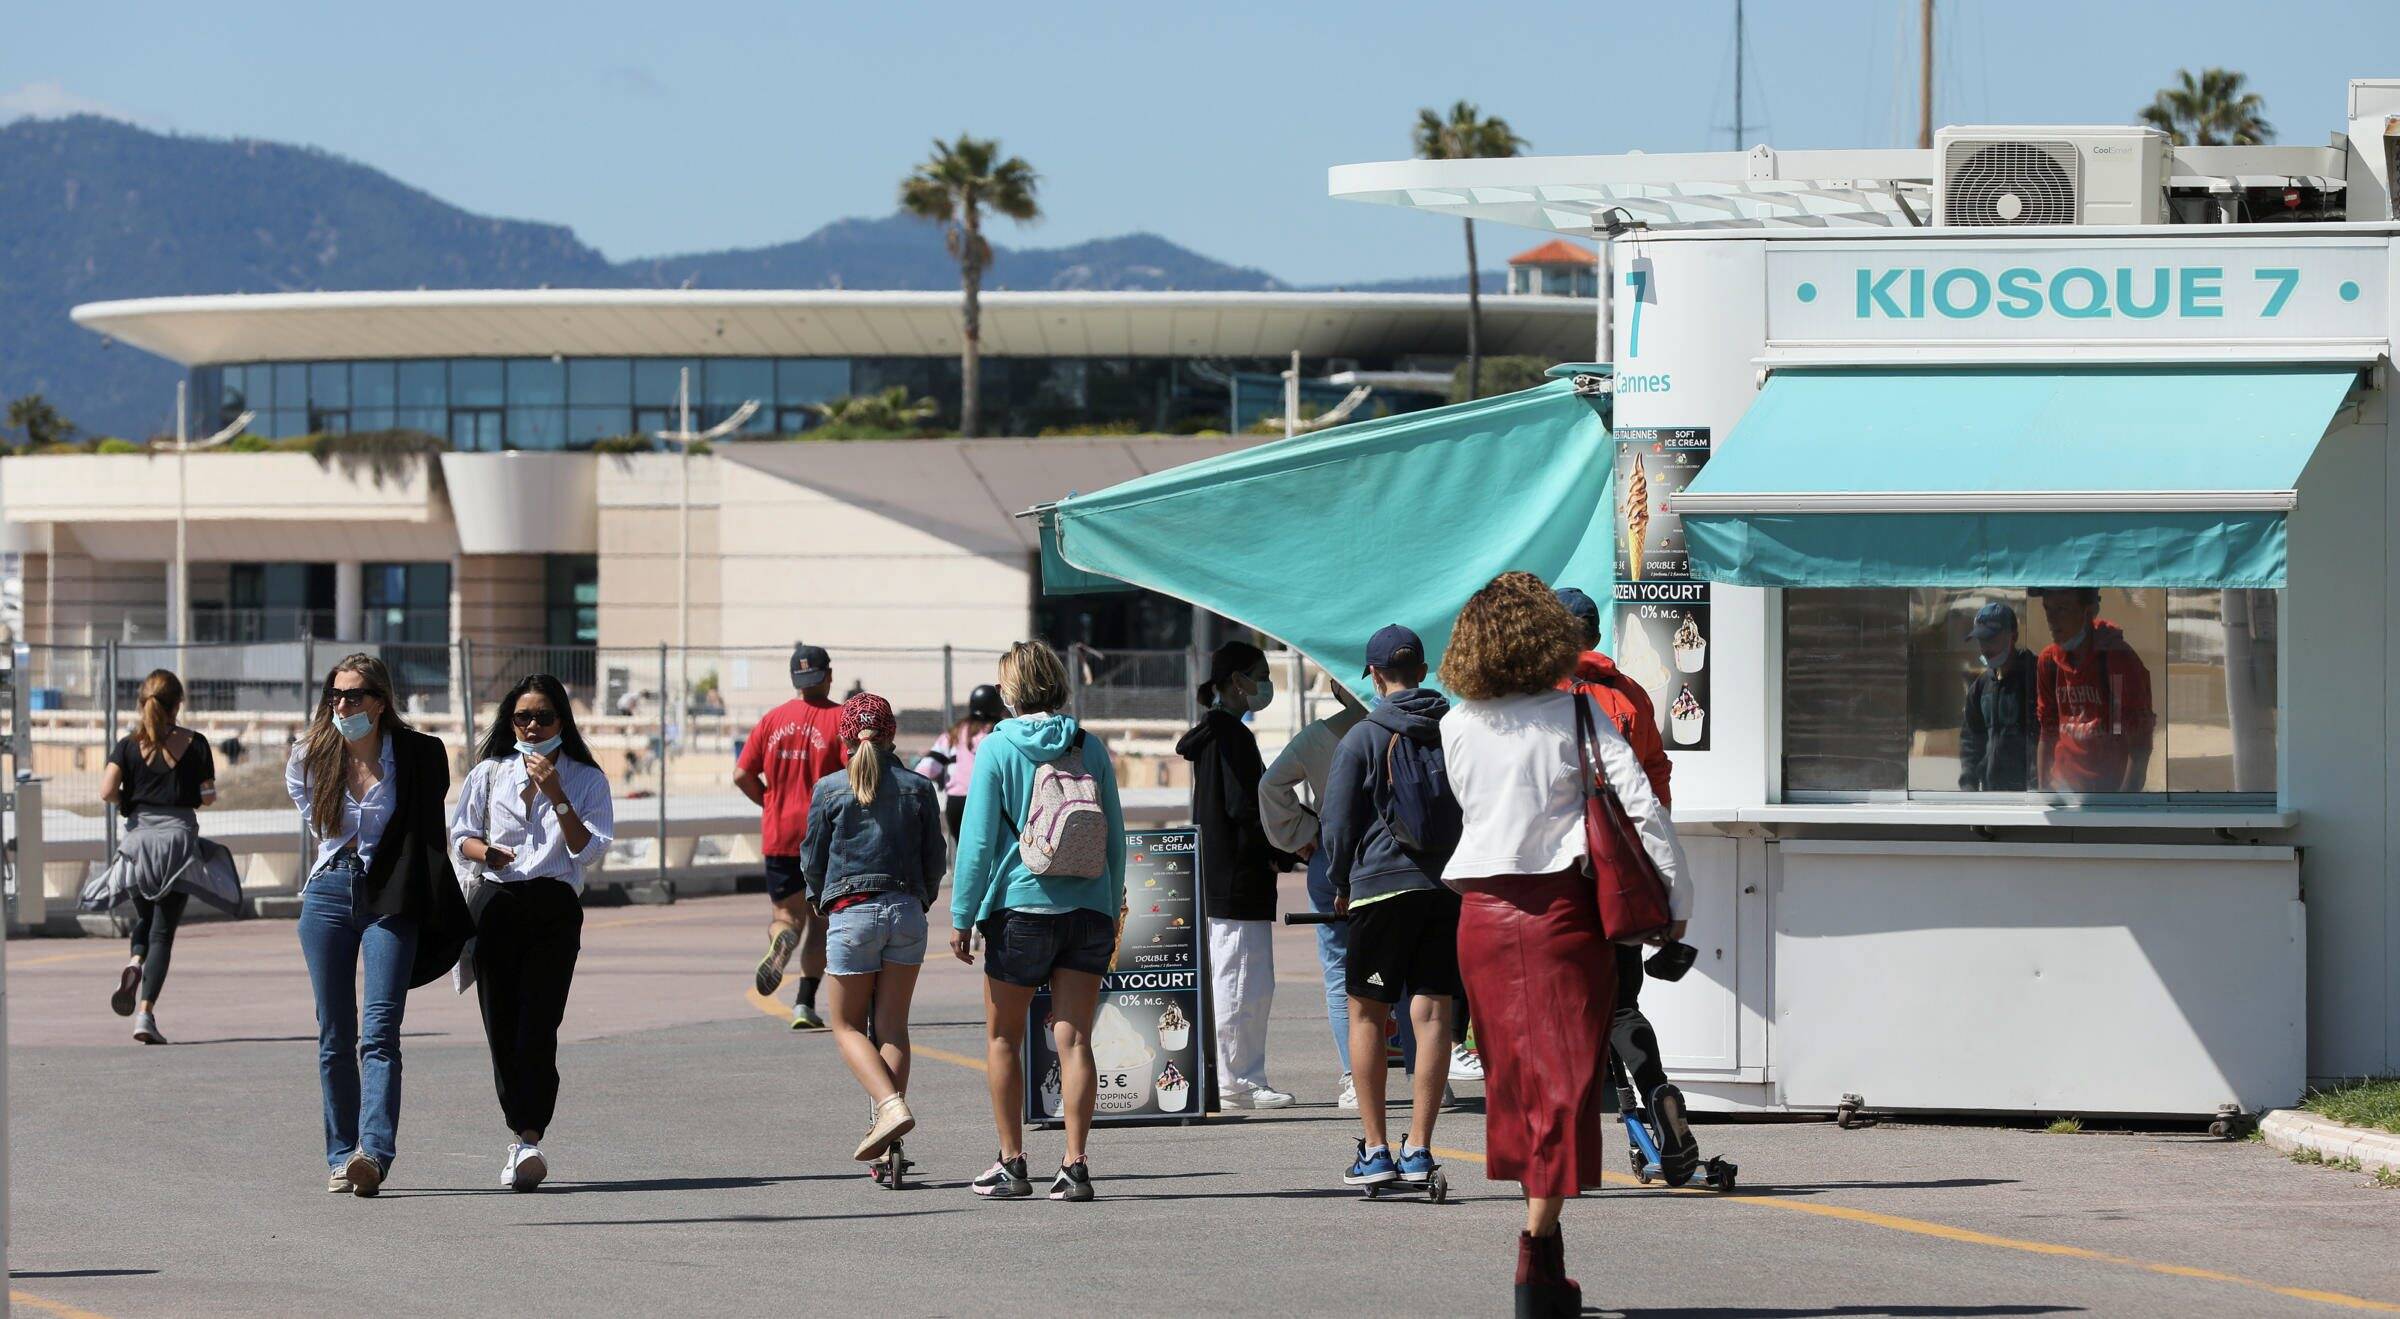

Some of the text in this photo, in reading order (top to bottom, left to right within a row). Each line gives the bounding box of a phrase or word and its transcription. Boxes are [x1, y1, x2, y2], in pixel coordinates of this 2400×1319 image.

[1855, 267, 2300, 319] KIOSQUE 7
[1626, 271, 1646, 358] 7
[1616, 372, 1671, 394] Cannes
[1675, 430, 1695, 438] SOFT
[1664, 439, 1707, 447] ICE CREAM
[1646, 561, 1688, 570] DOUBLE 5
[1640, 584, 1704, 600] YOGURT
[1640, 605, 1680, 619] 0% M.G.
[1162, 835, 1184, 843] SOFT
[1150, 843, 1196, 852] ICE CREAM
[1135, 953, 1189, 963] DOUBLE 5 €
[1118, 972, 1195, 989] YOGURT
[1119, 995, 1165, 1007] 0% M.G.
[1114, 1074, 1128, 1088] €
[1100, 1102, 1132, 1110] COULIS
